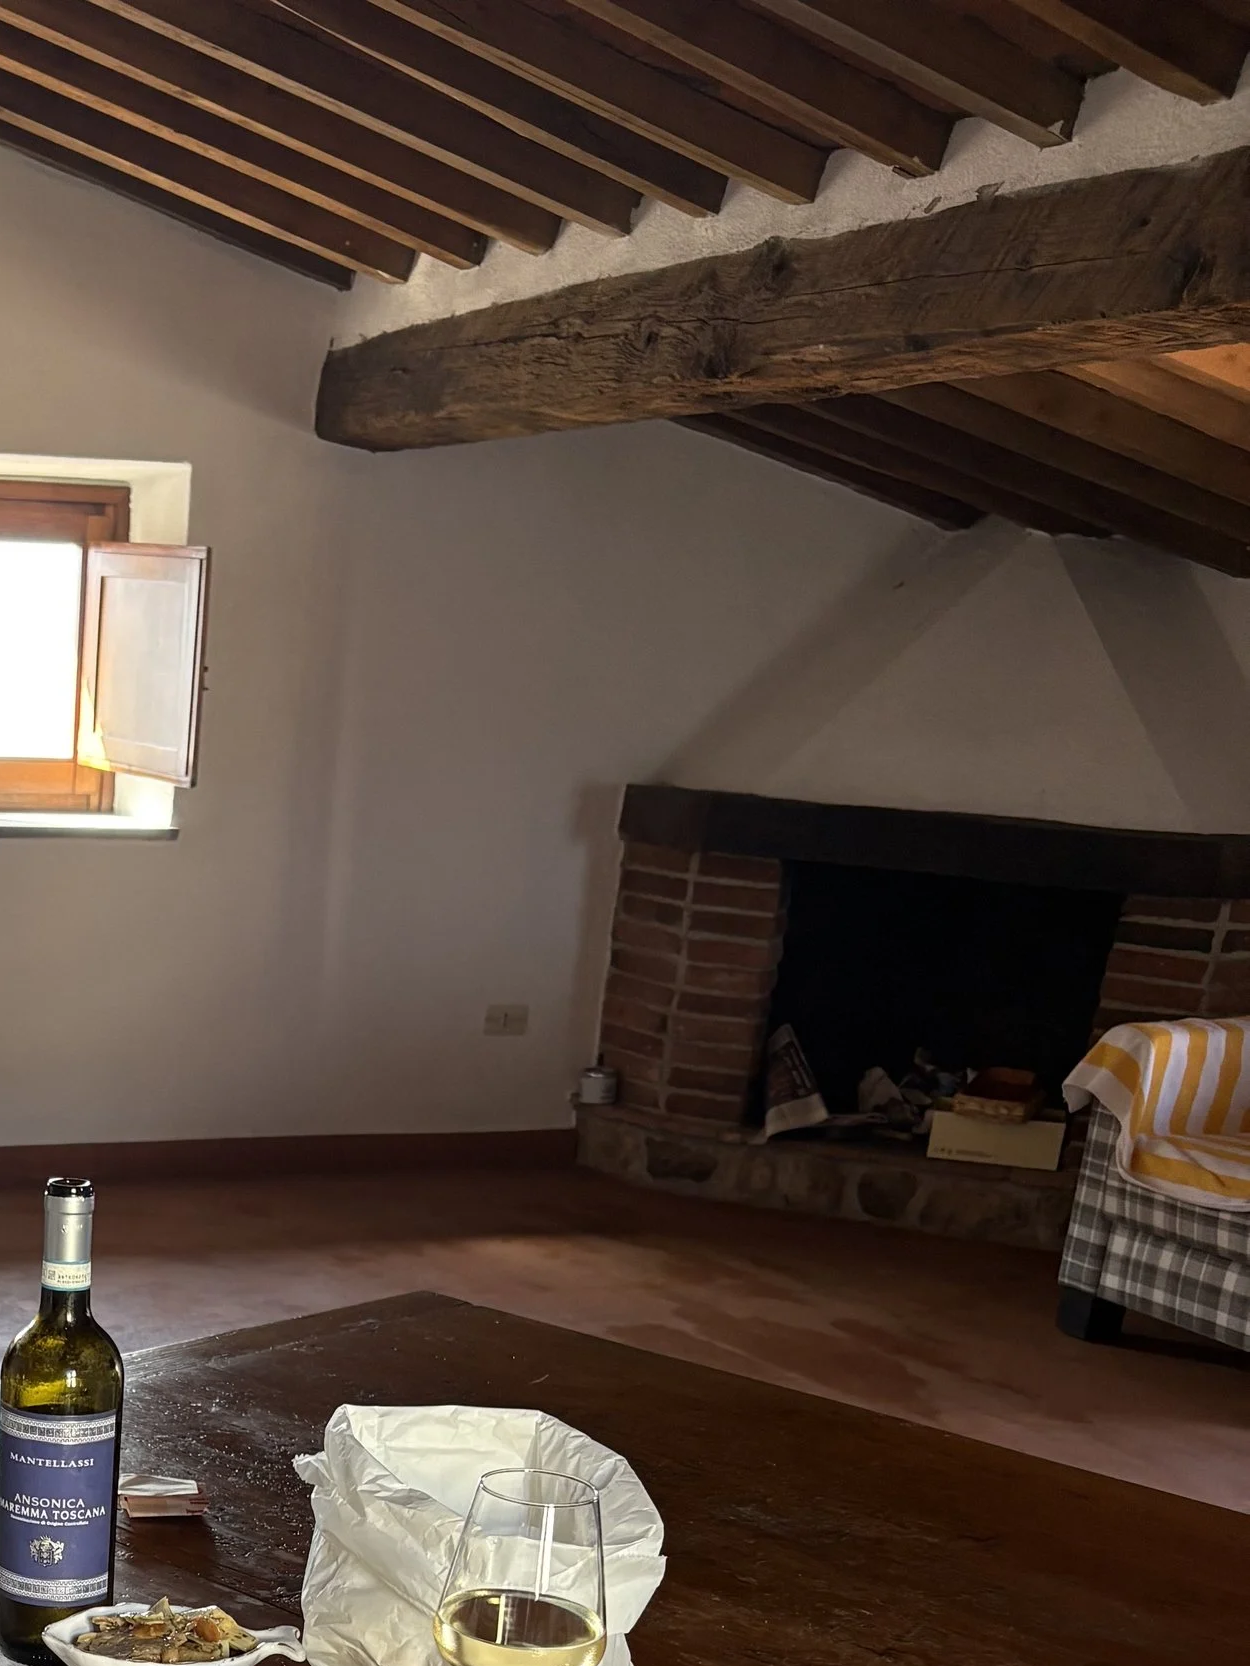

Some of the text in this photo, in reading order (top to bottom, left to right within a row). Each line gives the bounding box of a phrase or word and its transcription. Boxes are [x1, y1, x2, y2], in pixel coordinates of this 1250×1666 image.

[10, 1452, 94, 1468] MANTELLASSI
[0, 1496, 49, 1520] MAREMMA
[52, 1506, 106, 1520] TOSCANA
[14, 1493, 85, 1508] ANSONICA
